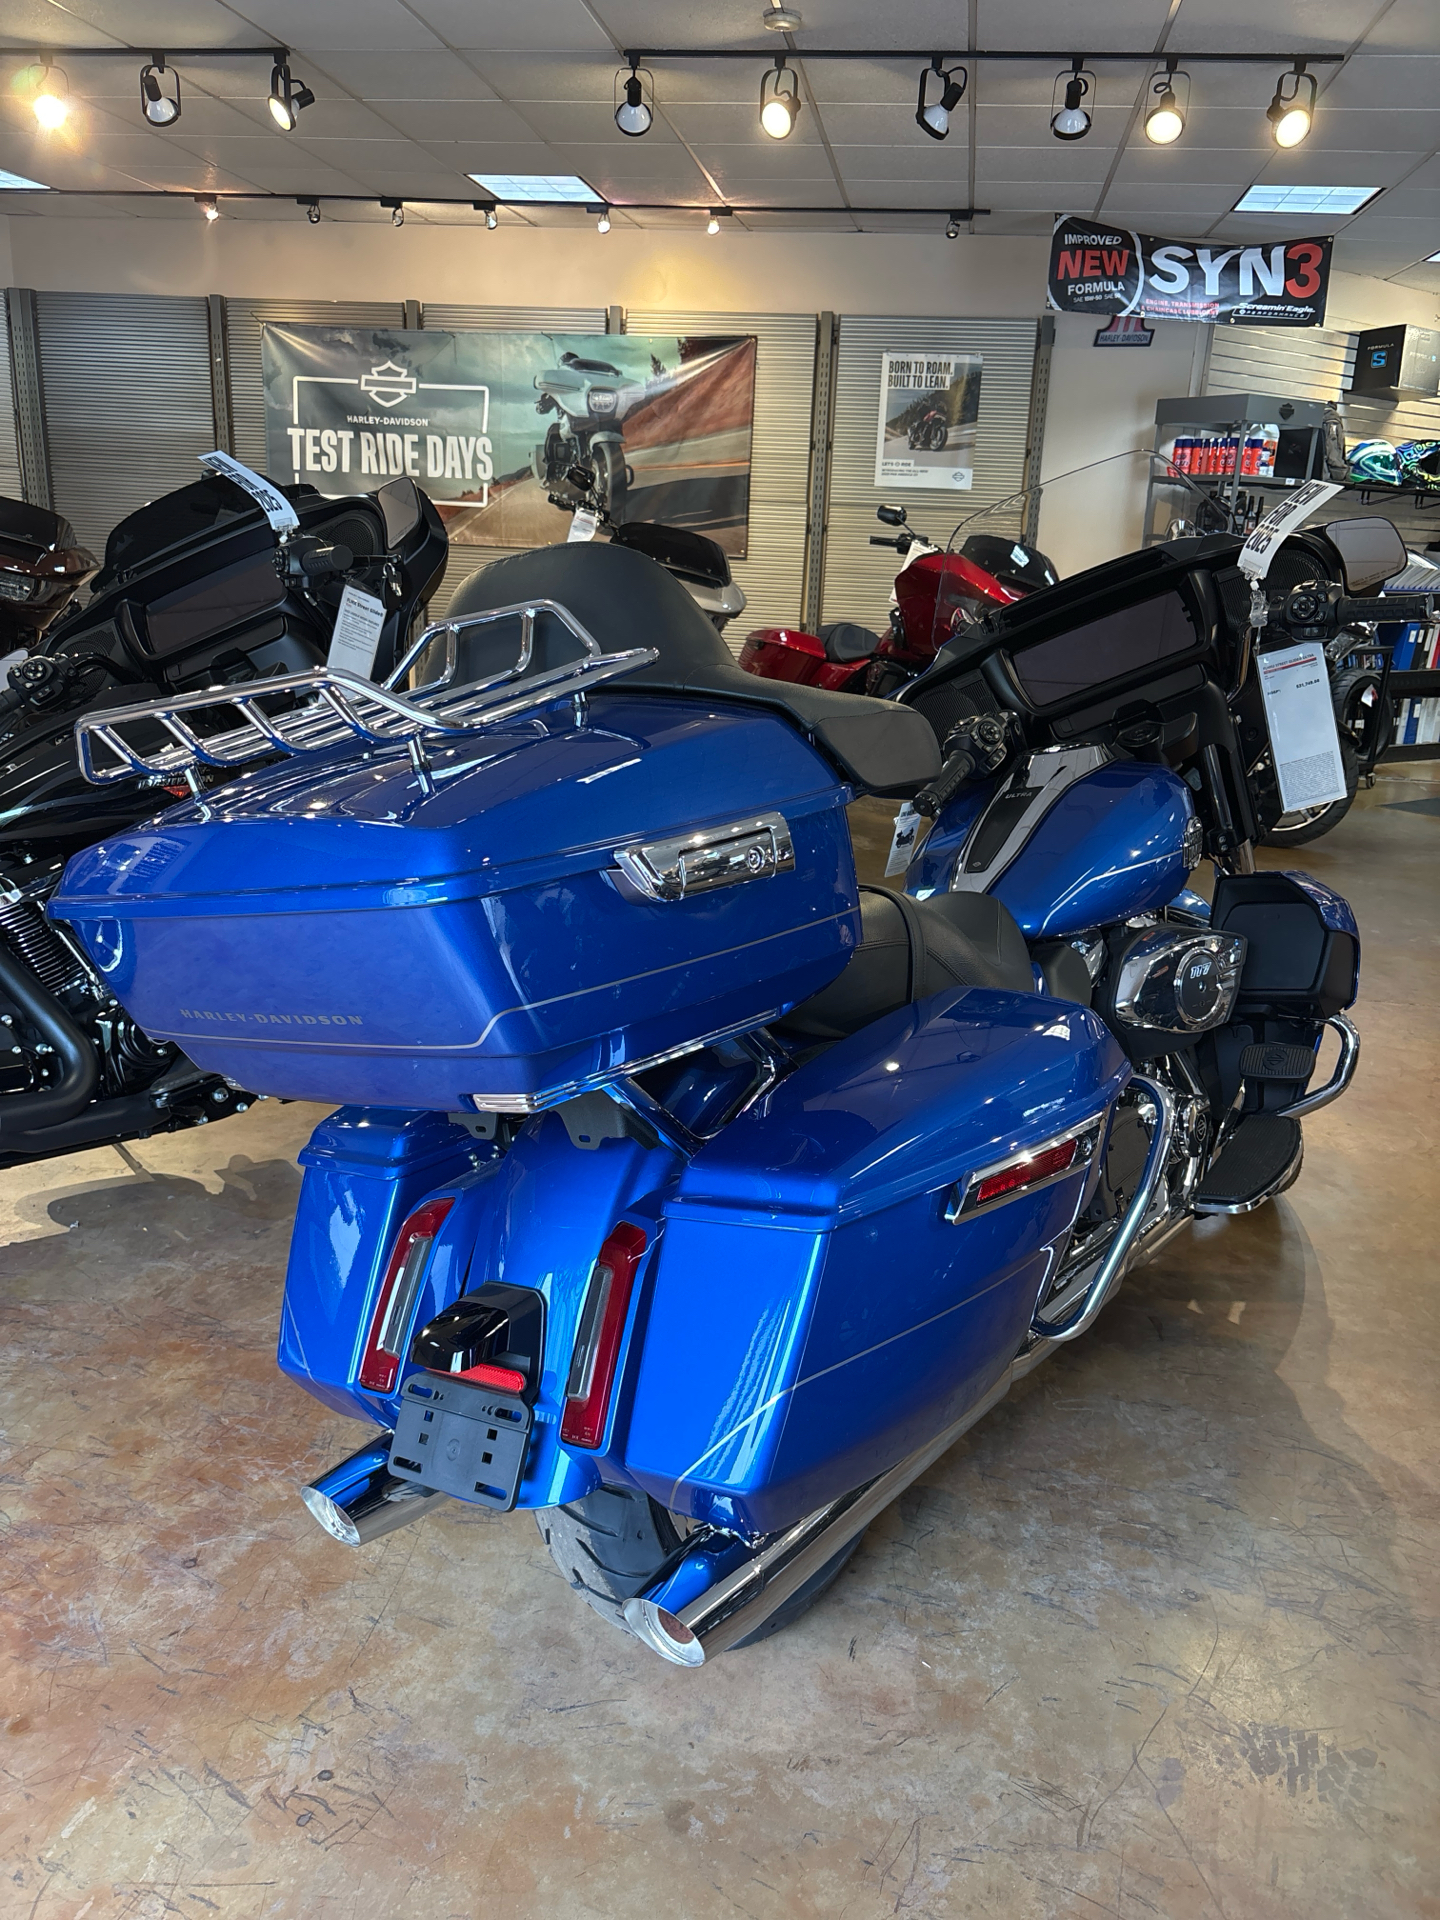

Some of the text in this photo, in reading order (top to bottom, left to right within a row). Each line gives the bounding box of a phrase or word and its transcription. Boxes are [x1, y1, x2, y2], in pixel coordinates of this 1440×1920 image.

[1064, 234, 1122, 245] IMPROVED
[1057, 249, 1130, 280] NEW
[1149, 242, 1323, 298] SYN3
[1067, 281, 1125, 296] FORMULA
[1146, 306, 1182, 314] CHAINCASE
[1171, 300, 1220, 309] TRANSMISSION
[1246, 310, 1305, 318] PERFORMANCE
[1367, 343, 1395, 351] FORMULA
[888, 360, 953, 376] BORN TO ROAM.
[887, 374, 949, 389] BUILT TO LEAN.
[346, 415, 429, 427] HARLEY-DAVIDSON
[287, 427, 493, 481] TEST RIDE DAYS
[251, 489, 283, 513] 2025
[1286, 481, 1330, 506] NEW
[1263, 501, 1298, 527] FOR
[1245, 523, 1280, 555] 2025
[1005, 791, 1032, 799] ULTRA
[1189, 962, 1212, 979] 117
[180, 1008, 364, 1026] HARLEY-DAVIDSON
